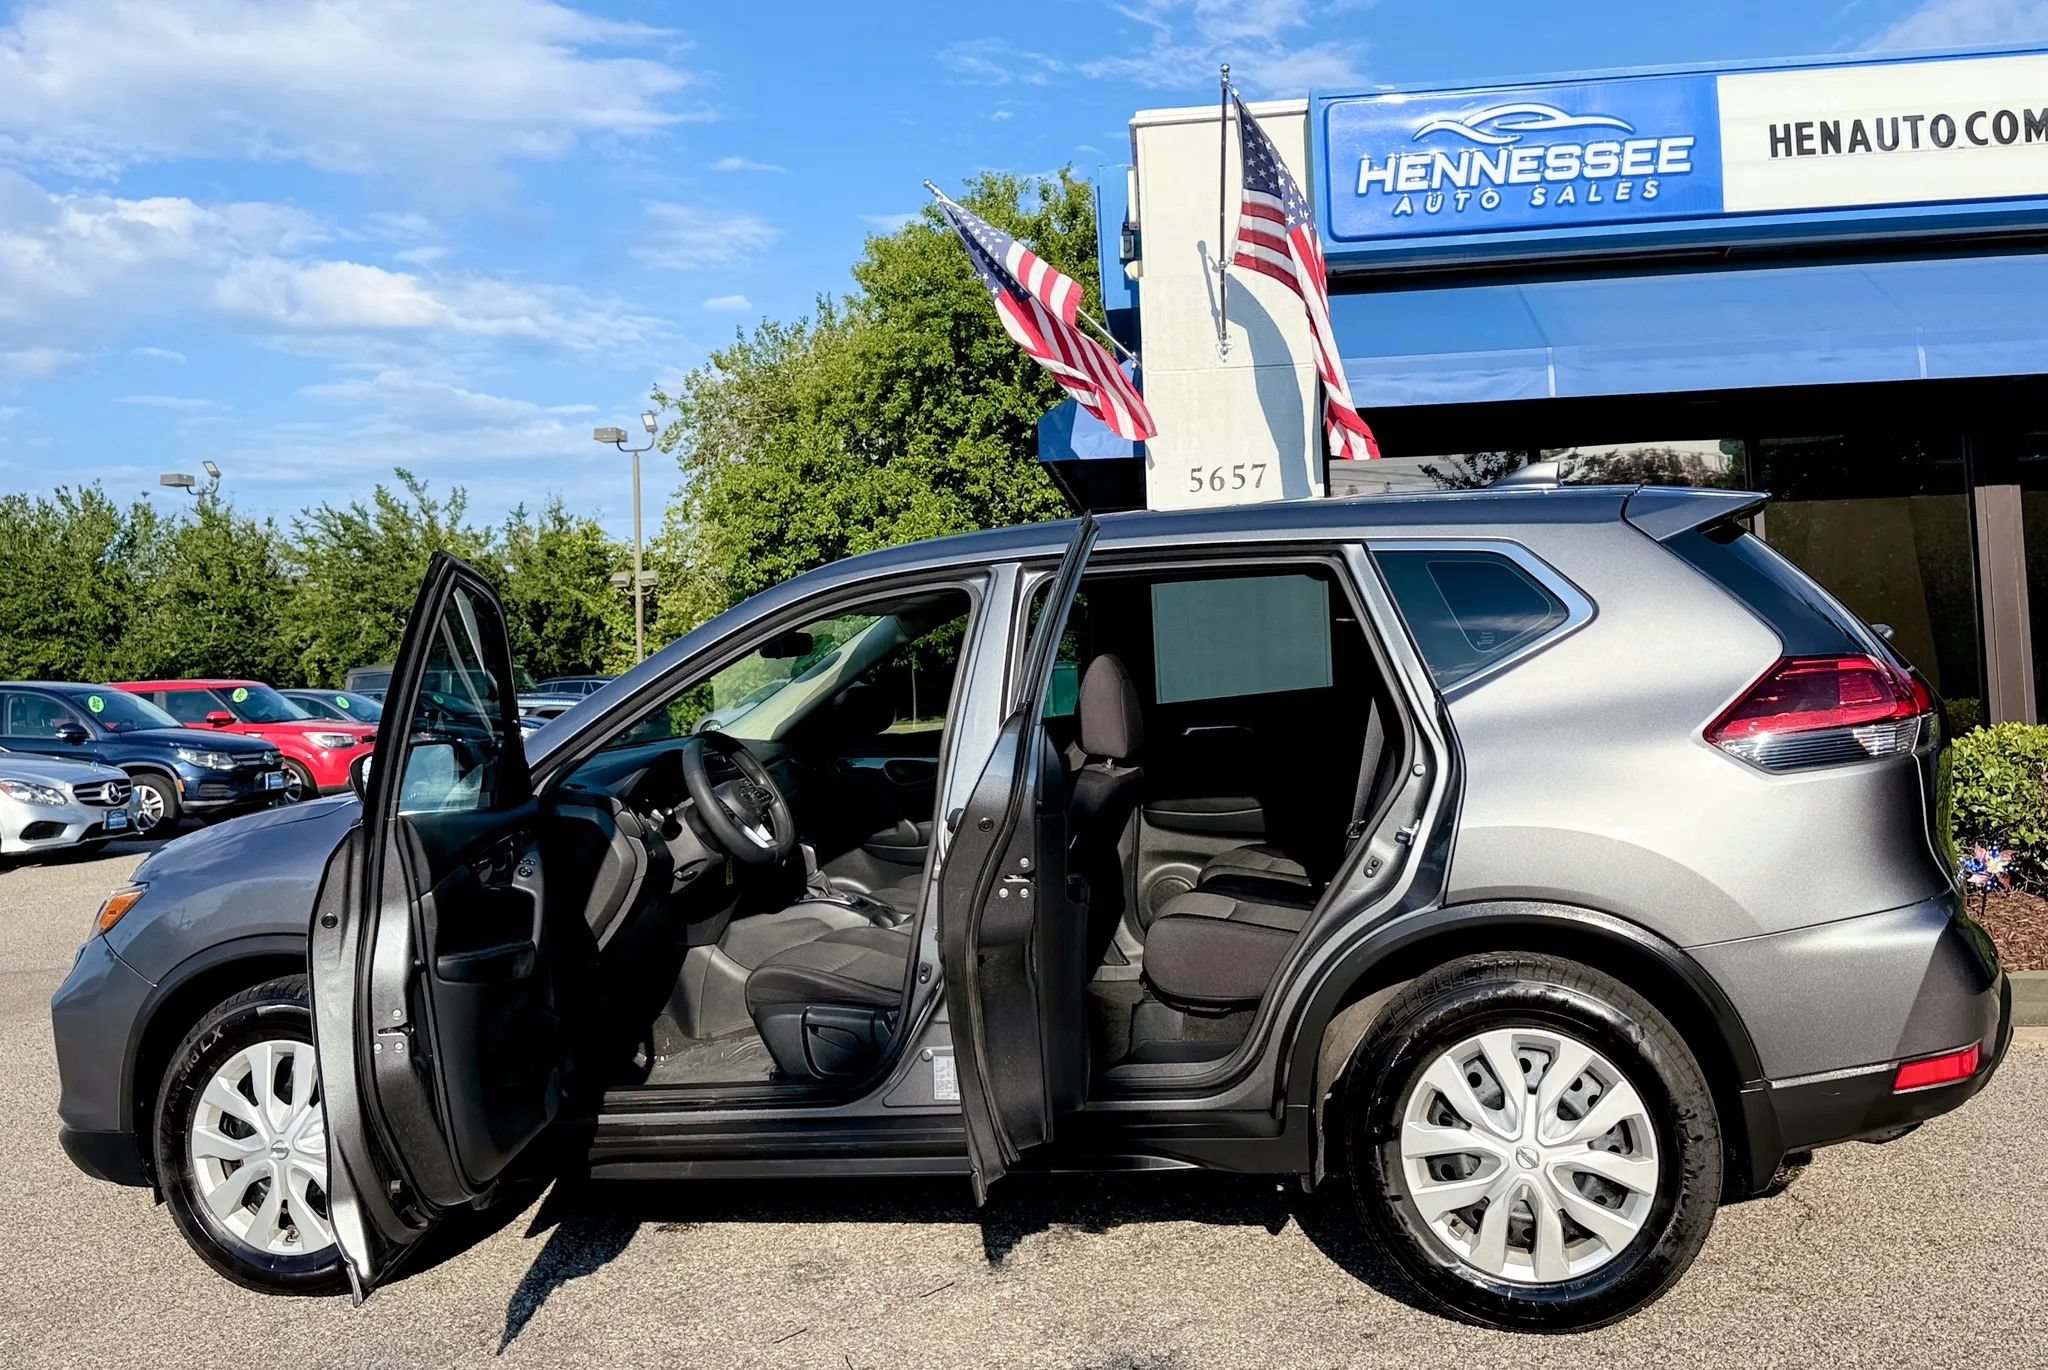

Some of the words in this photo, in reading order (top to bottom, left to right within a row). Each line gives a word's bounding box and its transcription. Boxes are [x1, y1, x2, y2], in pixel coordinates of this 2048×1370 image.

[1357, 136, 1696, 195] HENNESSEE
[1394, 190, 1502, 217] AUTO
[1530, 179, 1661, 207] SALES
[1189, 462, 1267, 493] 5657
[200, 1024, 225, 1053] LX
